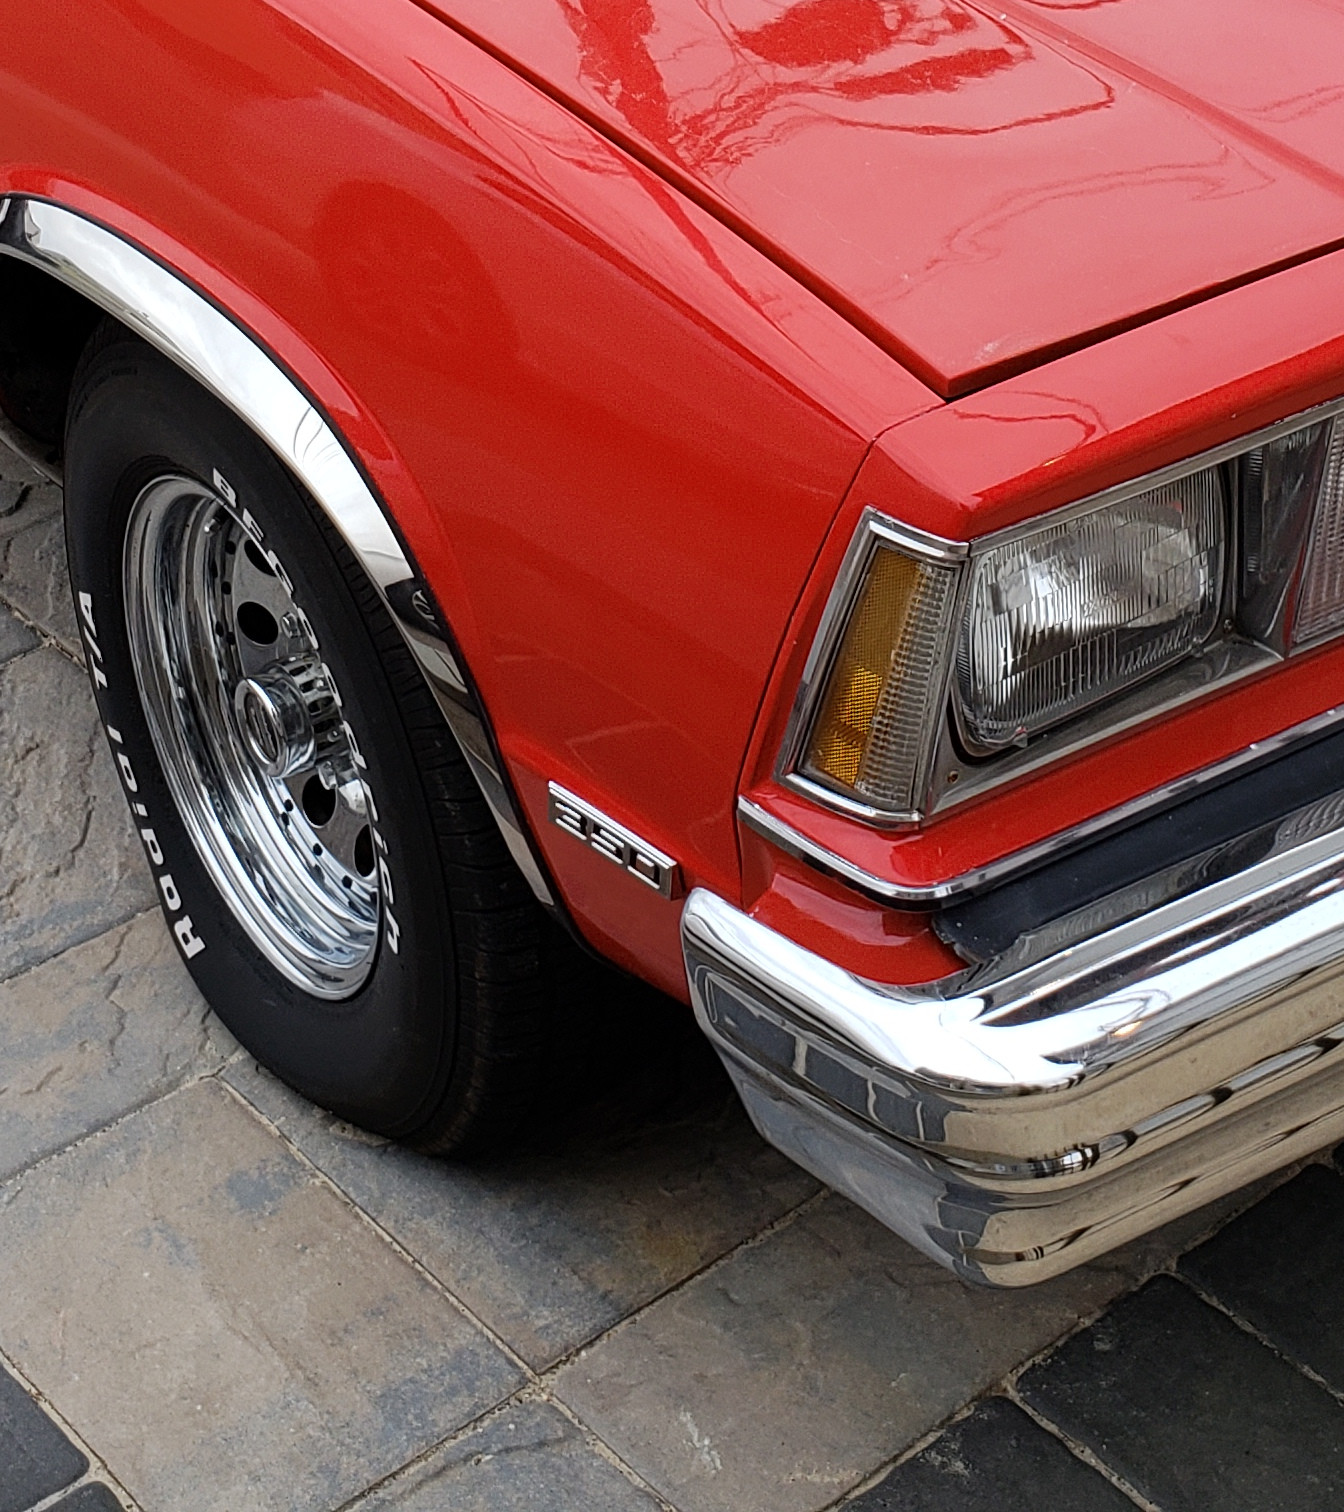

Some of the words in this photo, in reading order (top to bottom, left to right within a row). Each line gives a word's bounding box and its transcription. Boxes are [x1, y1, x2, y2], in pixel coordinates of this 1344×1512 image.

[78, 590, 109, 690] T/A
[106, 723, 206, 960] Radial
[554, 799, 662, 891] 350
